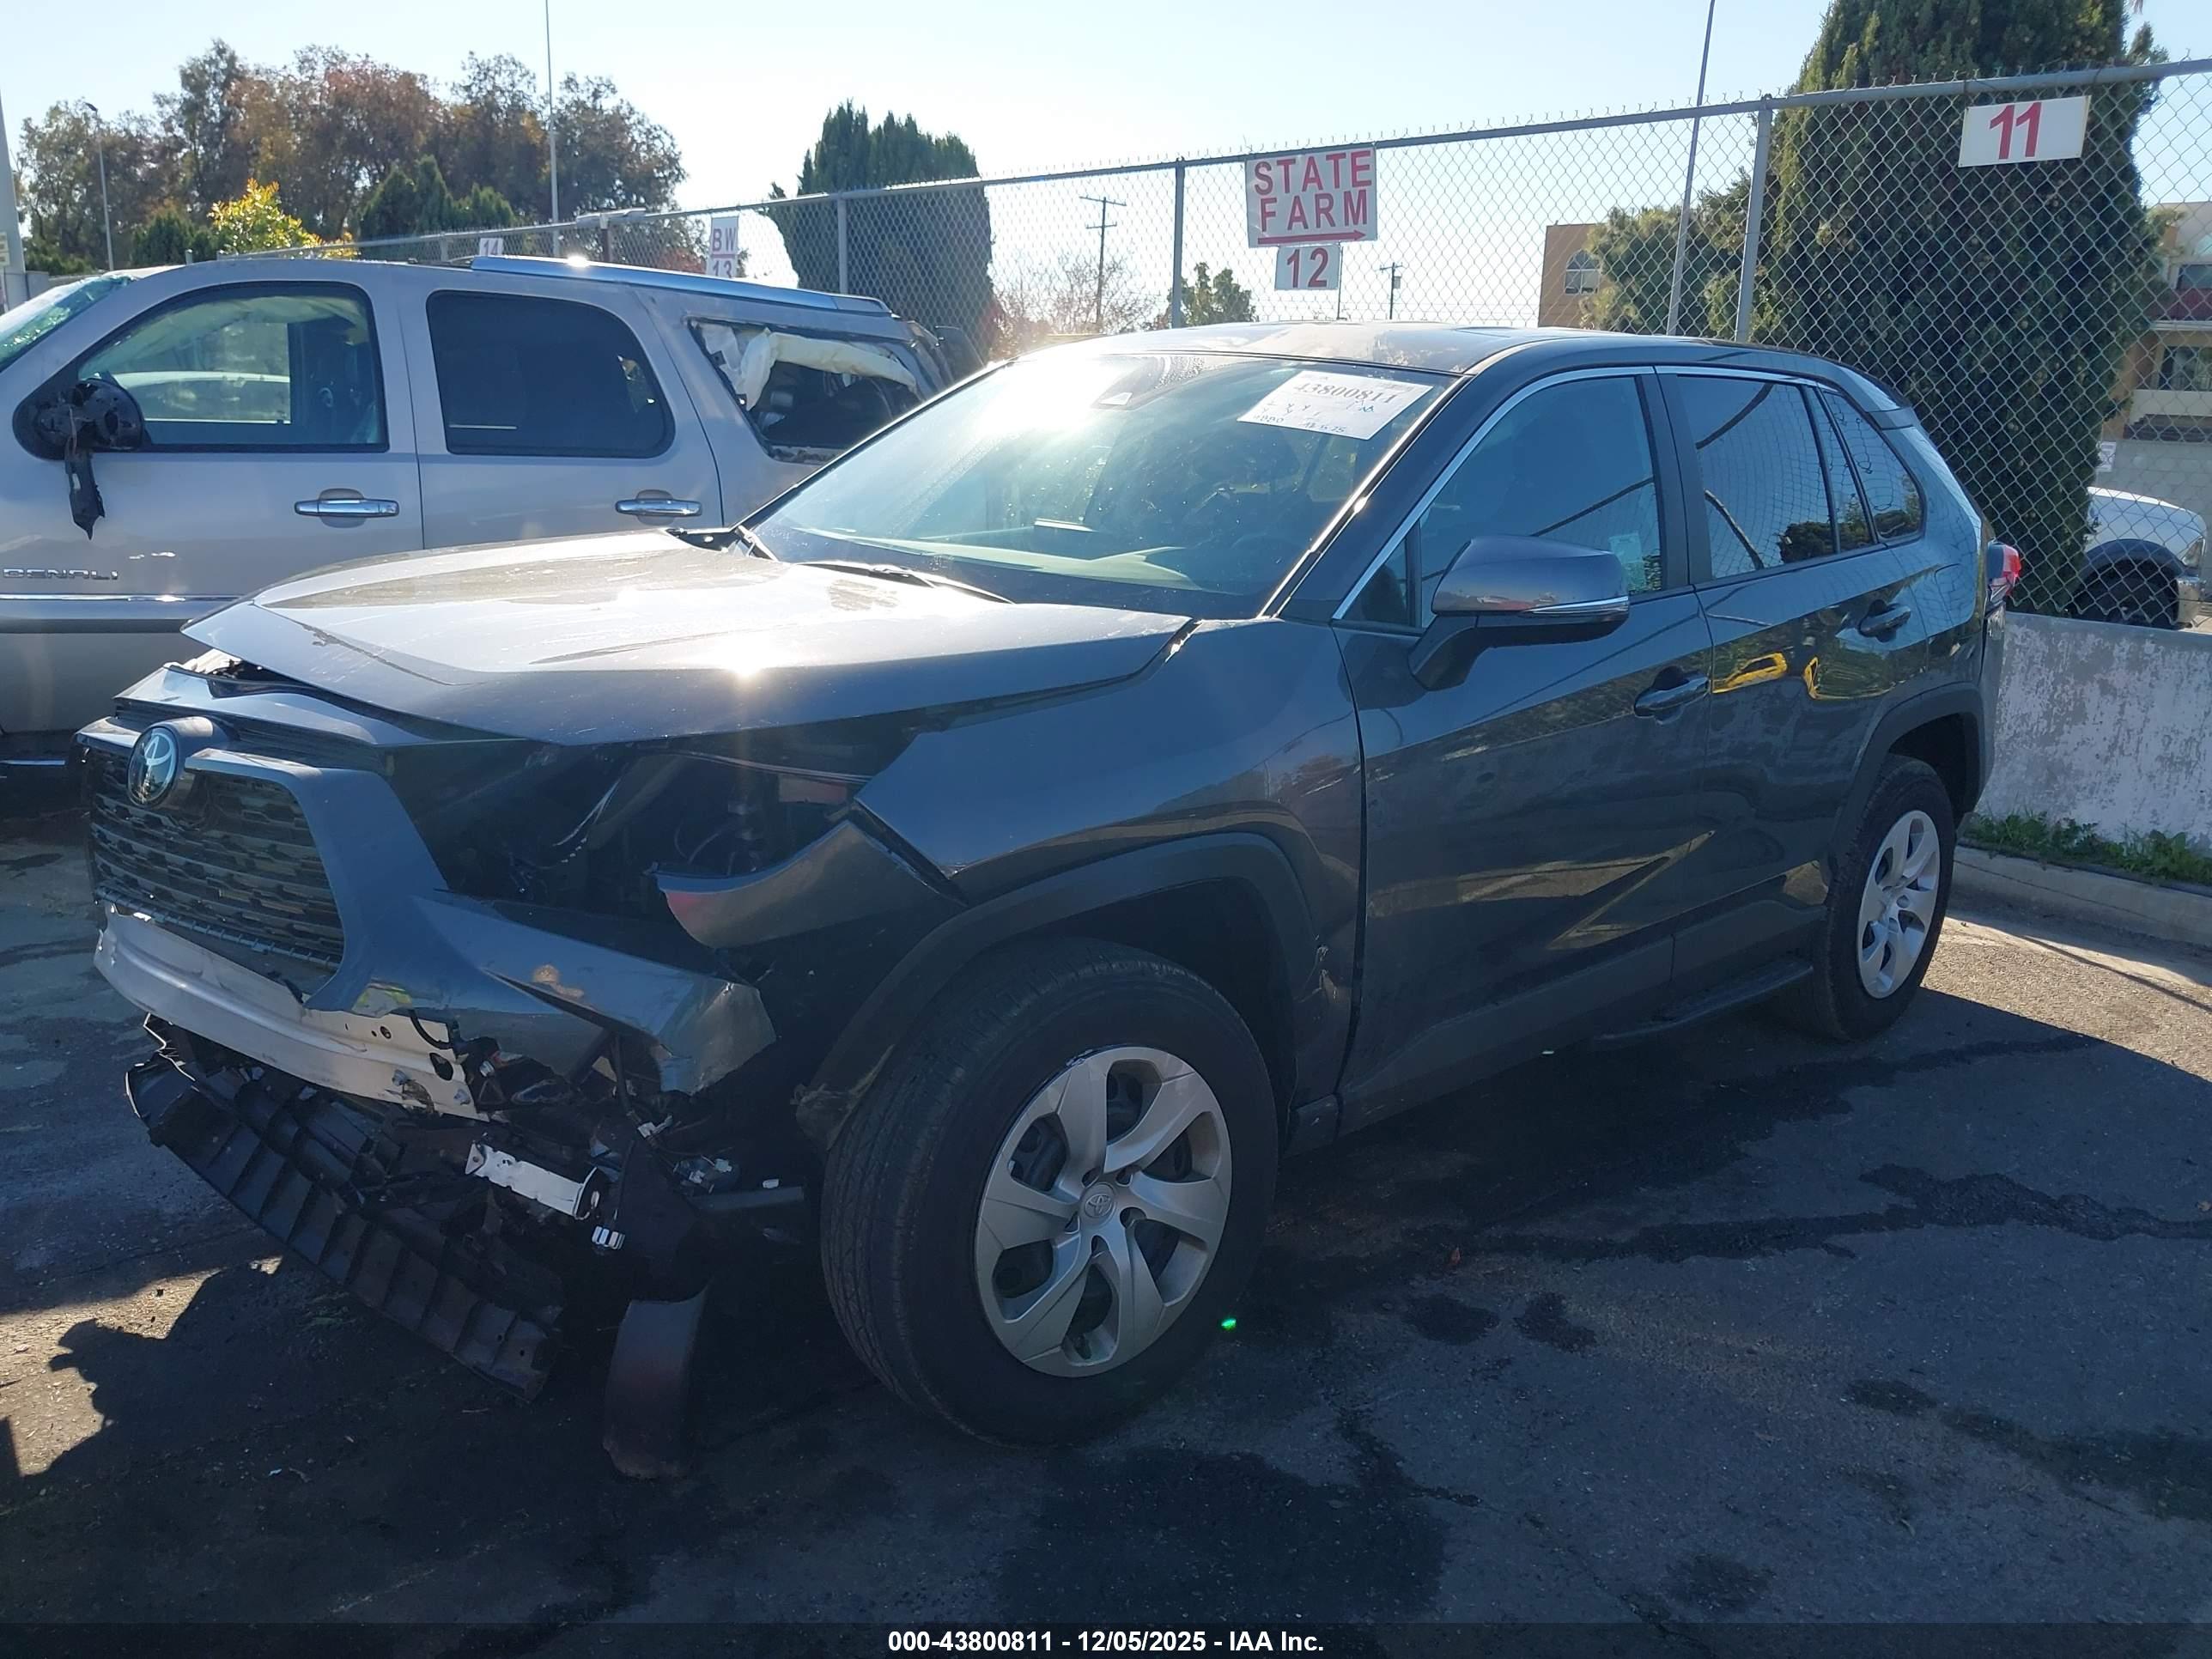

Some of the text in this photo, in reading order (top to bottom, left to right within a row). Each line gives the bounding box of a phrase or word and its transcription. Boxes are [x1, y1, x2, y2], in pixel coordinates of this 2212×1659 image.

[1990, 101, 2042, 160] 11
[1254, 150, 1372, 196] STATE
[1260, 189, 1368, 232] FARM
[1286, 247, 1329, 288] 12
[3, 568, 118, 580] DENALI
